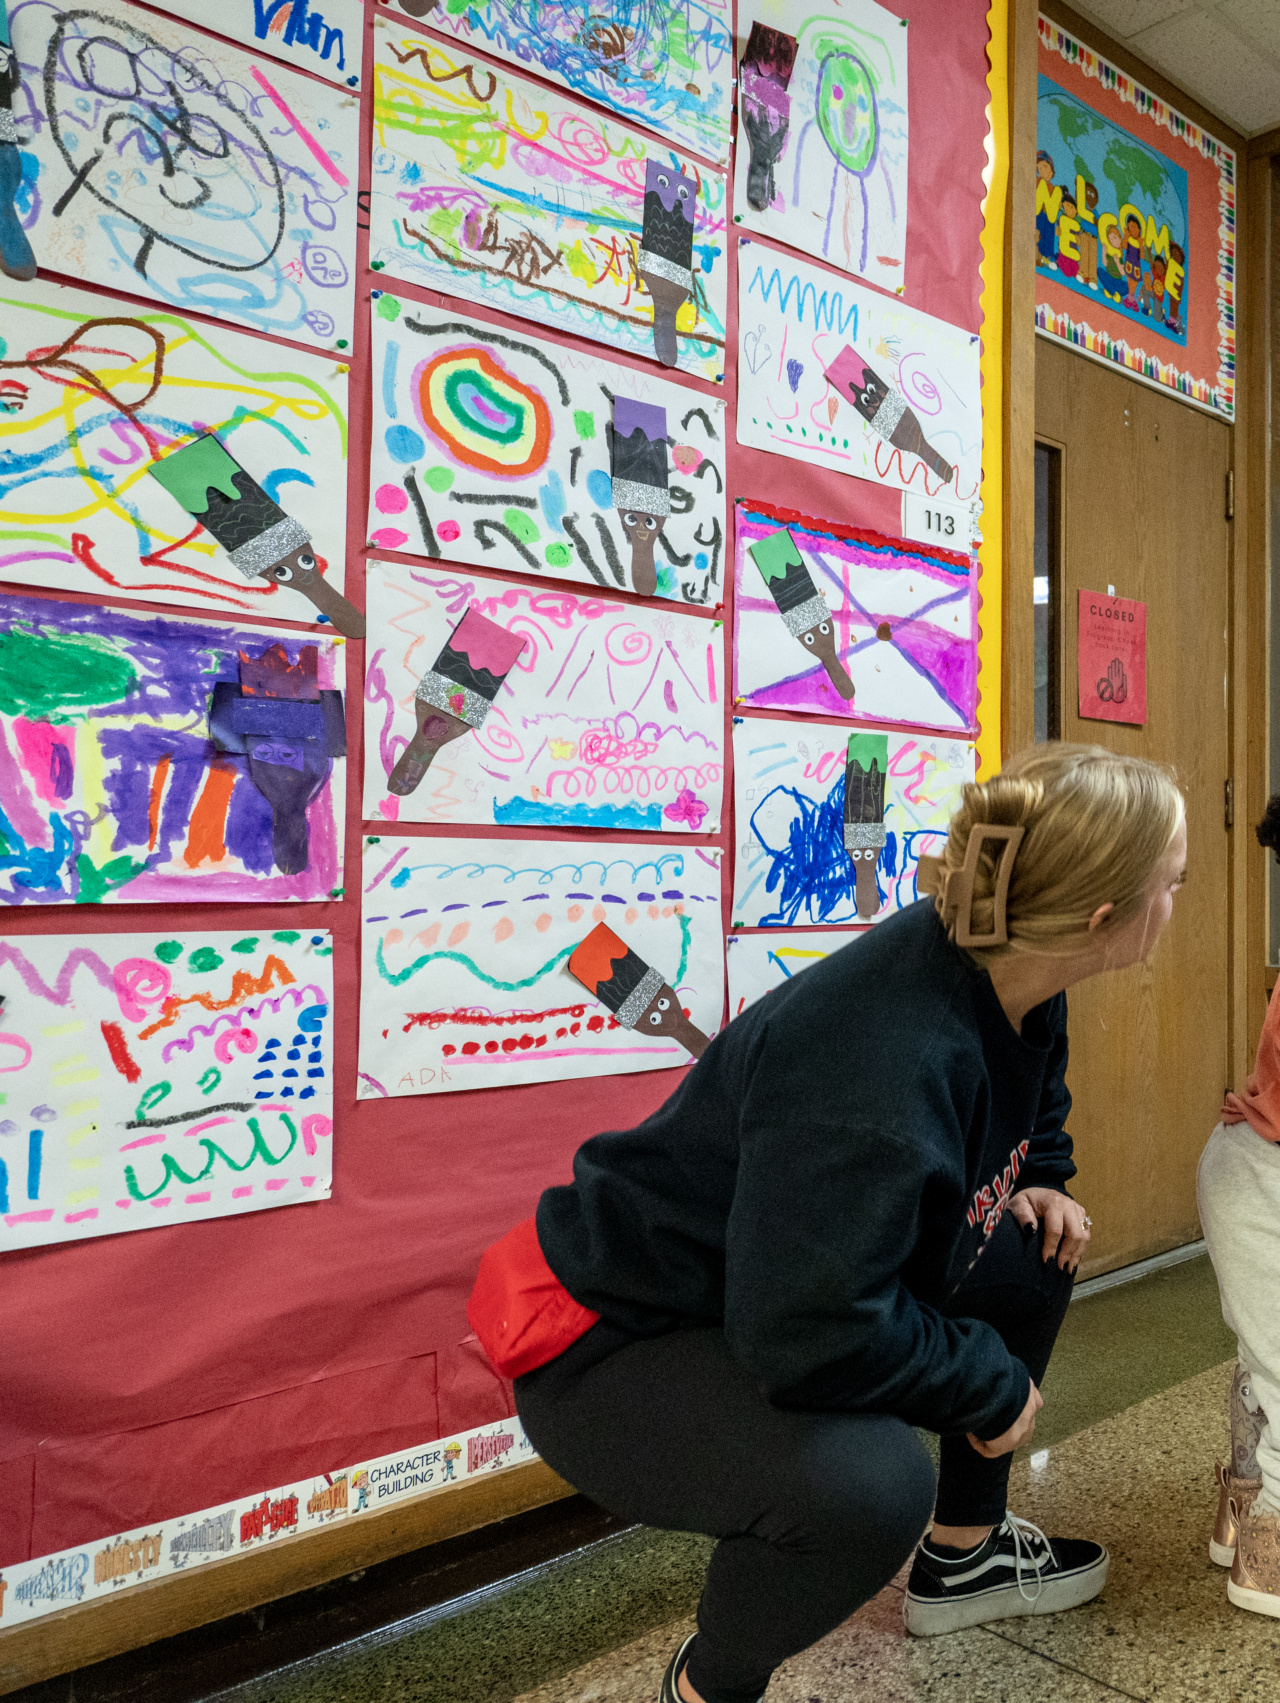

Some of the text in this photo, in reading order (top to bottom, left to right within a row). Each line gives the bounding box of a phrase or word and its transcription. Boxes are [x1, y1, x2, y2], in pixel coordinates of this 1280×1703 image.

[925, 510, 955, 536] 113
[1089, 605, 1135, 623] CLOSED
[398, 1066, 452, 1088] ADA
[370, 1450, 441, 1483] CHARACTER
[378, 1469, 434, 1498] BUILDING
[94, 1535, 163, 1585] HONESTY
